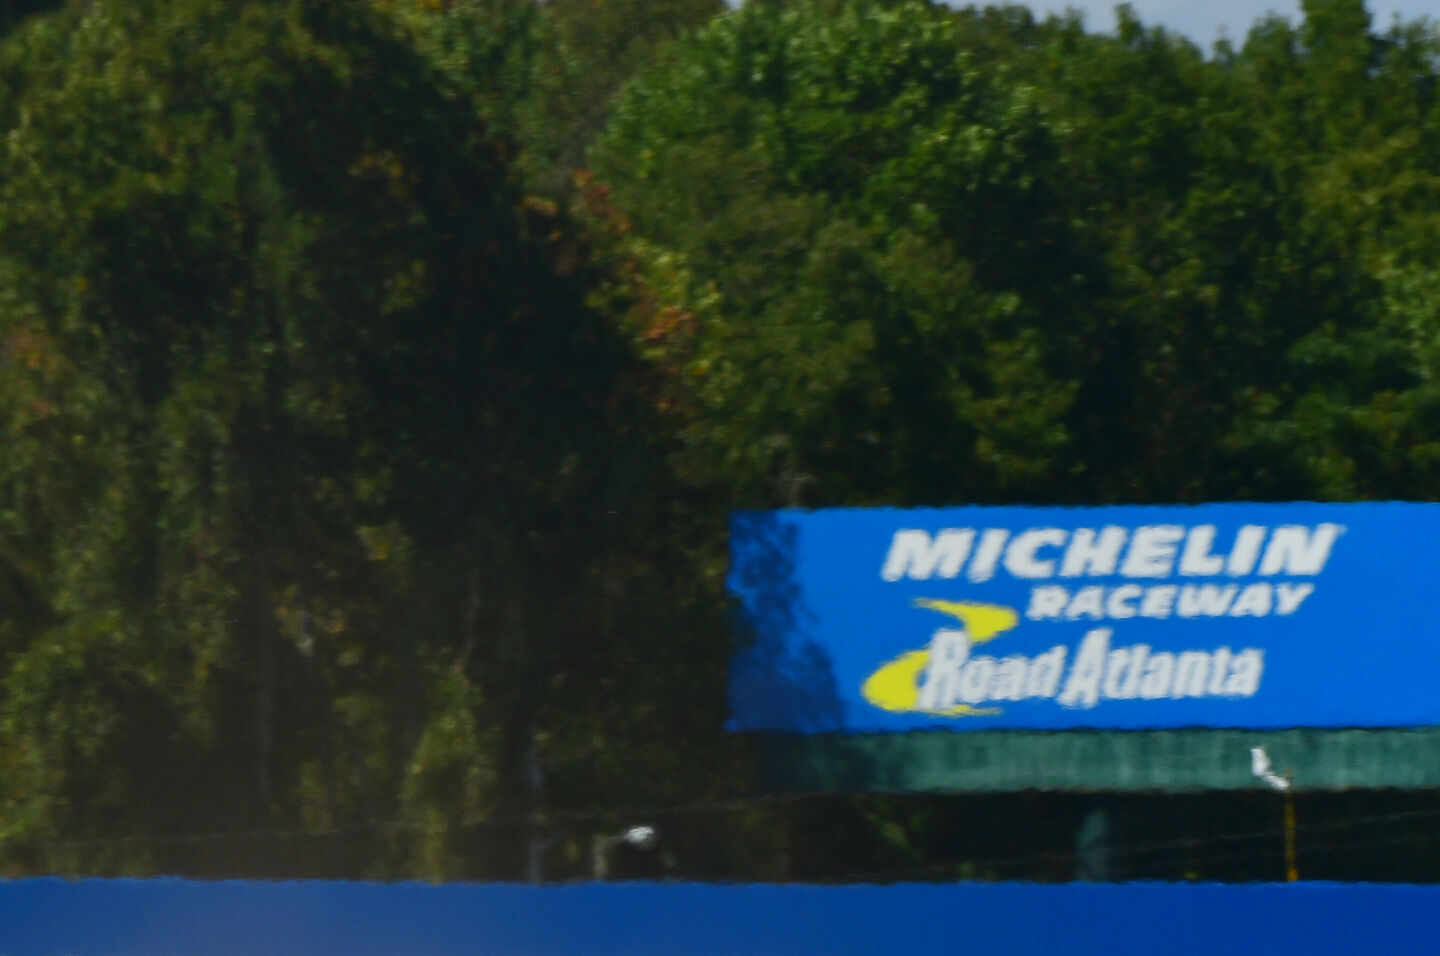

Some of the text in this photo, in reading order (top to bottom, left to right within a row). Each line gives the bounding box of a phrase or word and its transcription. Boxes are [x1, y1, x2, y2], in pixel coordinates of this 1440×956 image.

[881, 523, 1341, 582] MICHELIN
[1025, 583, 1316, 621] RACEWAY
[915, 627, 1266, 711] Road Atlanta
